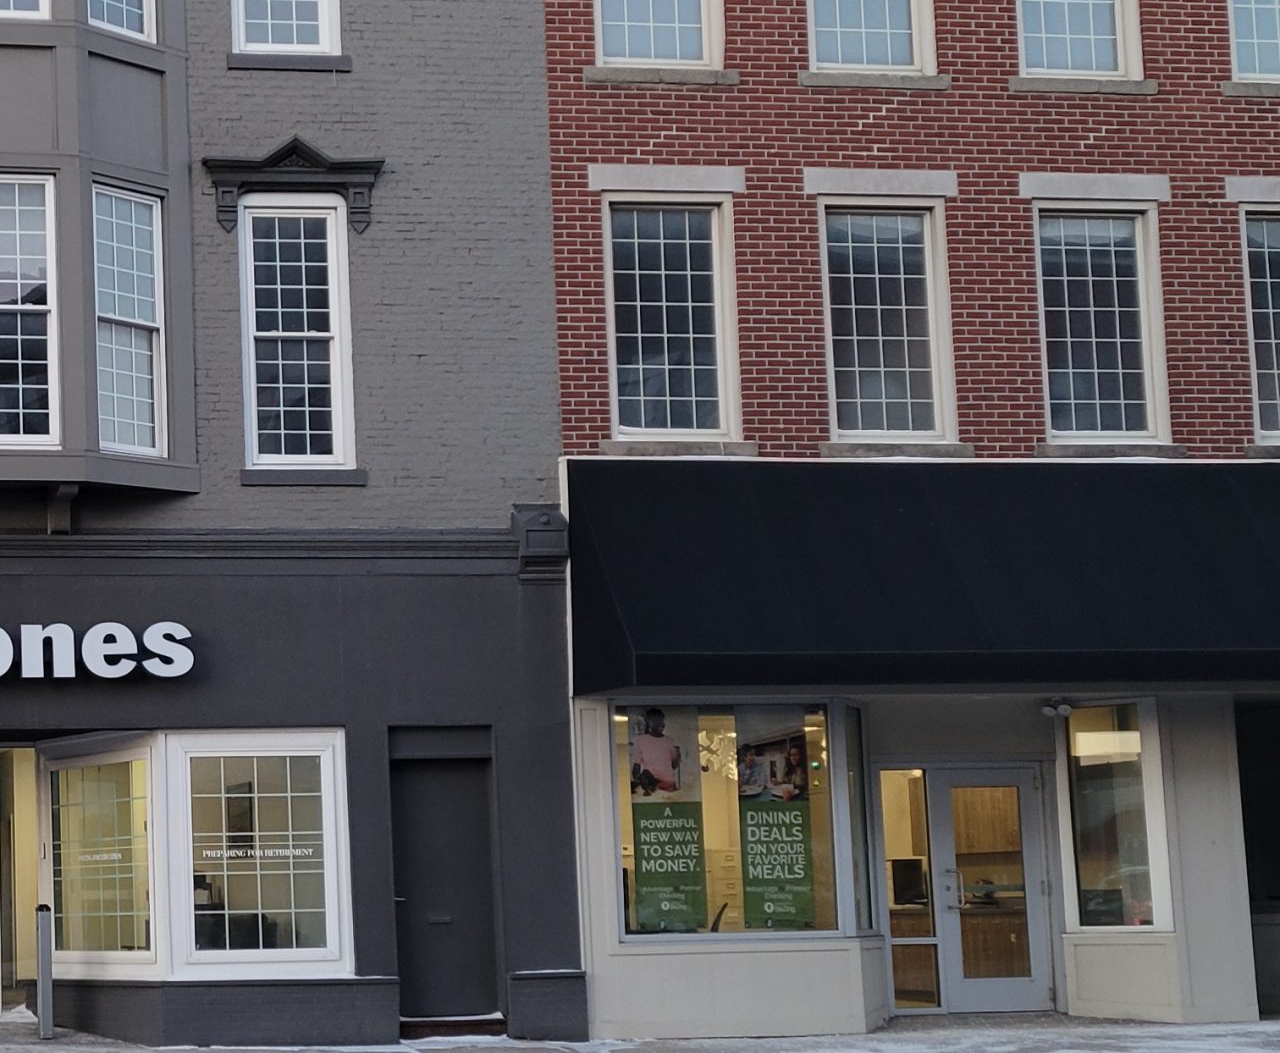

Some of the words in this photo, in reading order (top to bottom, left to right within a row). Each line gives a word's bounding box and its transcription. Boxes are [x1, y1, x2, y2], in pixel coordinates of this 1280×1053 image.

[664, 806, 673, 817] A
[640, 818, 698, 829] POWERFUL
[746, 811, 803, 825] DINING
[640, 832, 671, 843] NEW
[672, 831, 700, 842] WAY
[747, 826, 804, 841] DEALS
[640, 845, 662, 857] TO
[664, 844, 700, 857] SAVE
[747, 843, 767, 854] ON
[769, 843, 805, 854] YOUR
[747, 854, 807, 865] FAVORITE
[641, 859, 700, 873] MONEY.
[748, 864, 805, 879] MEALS
